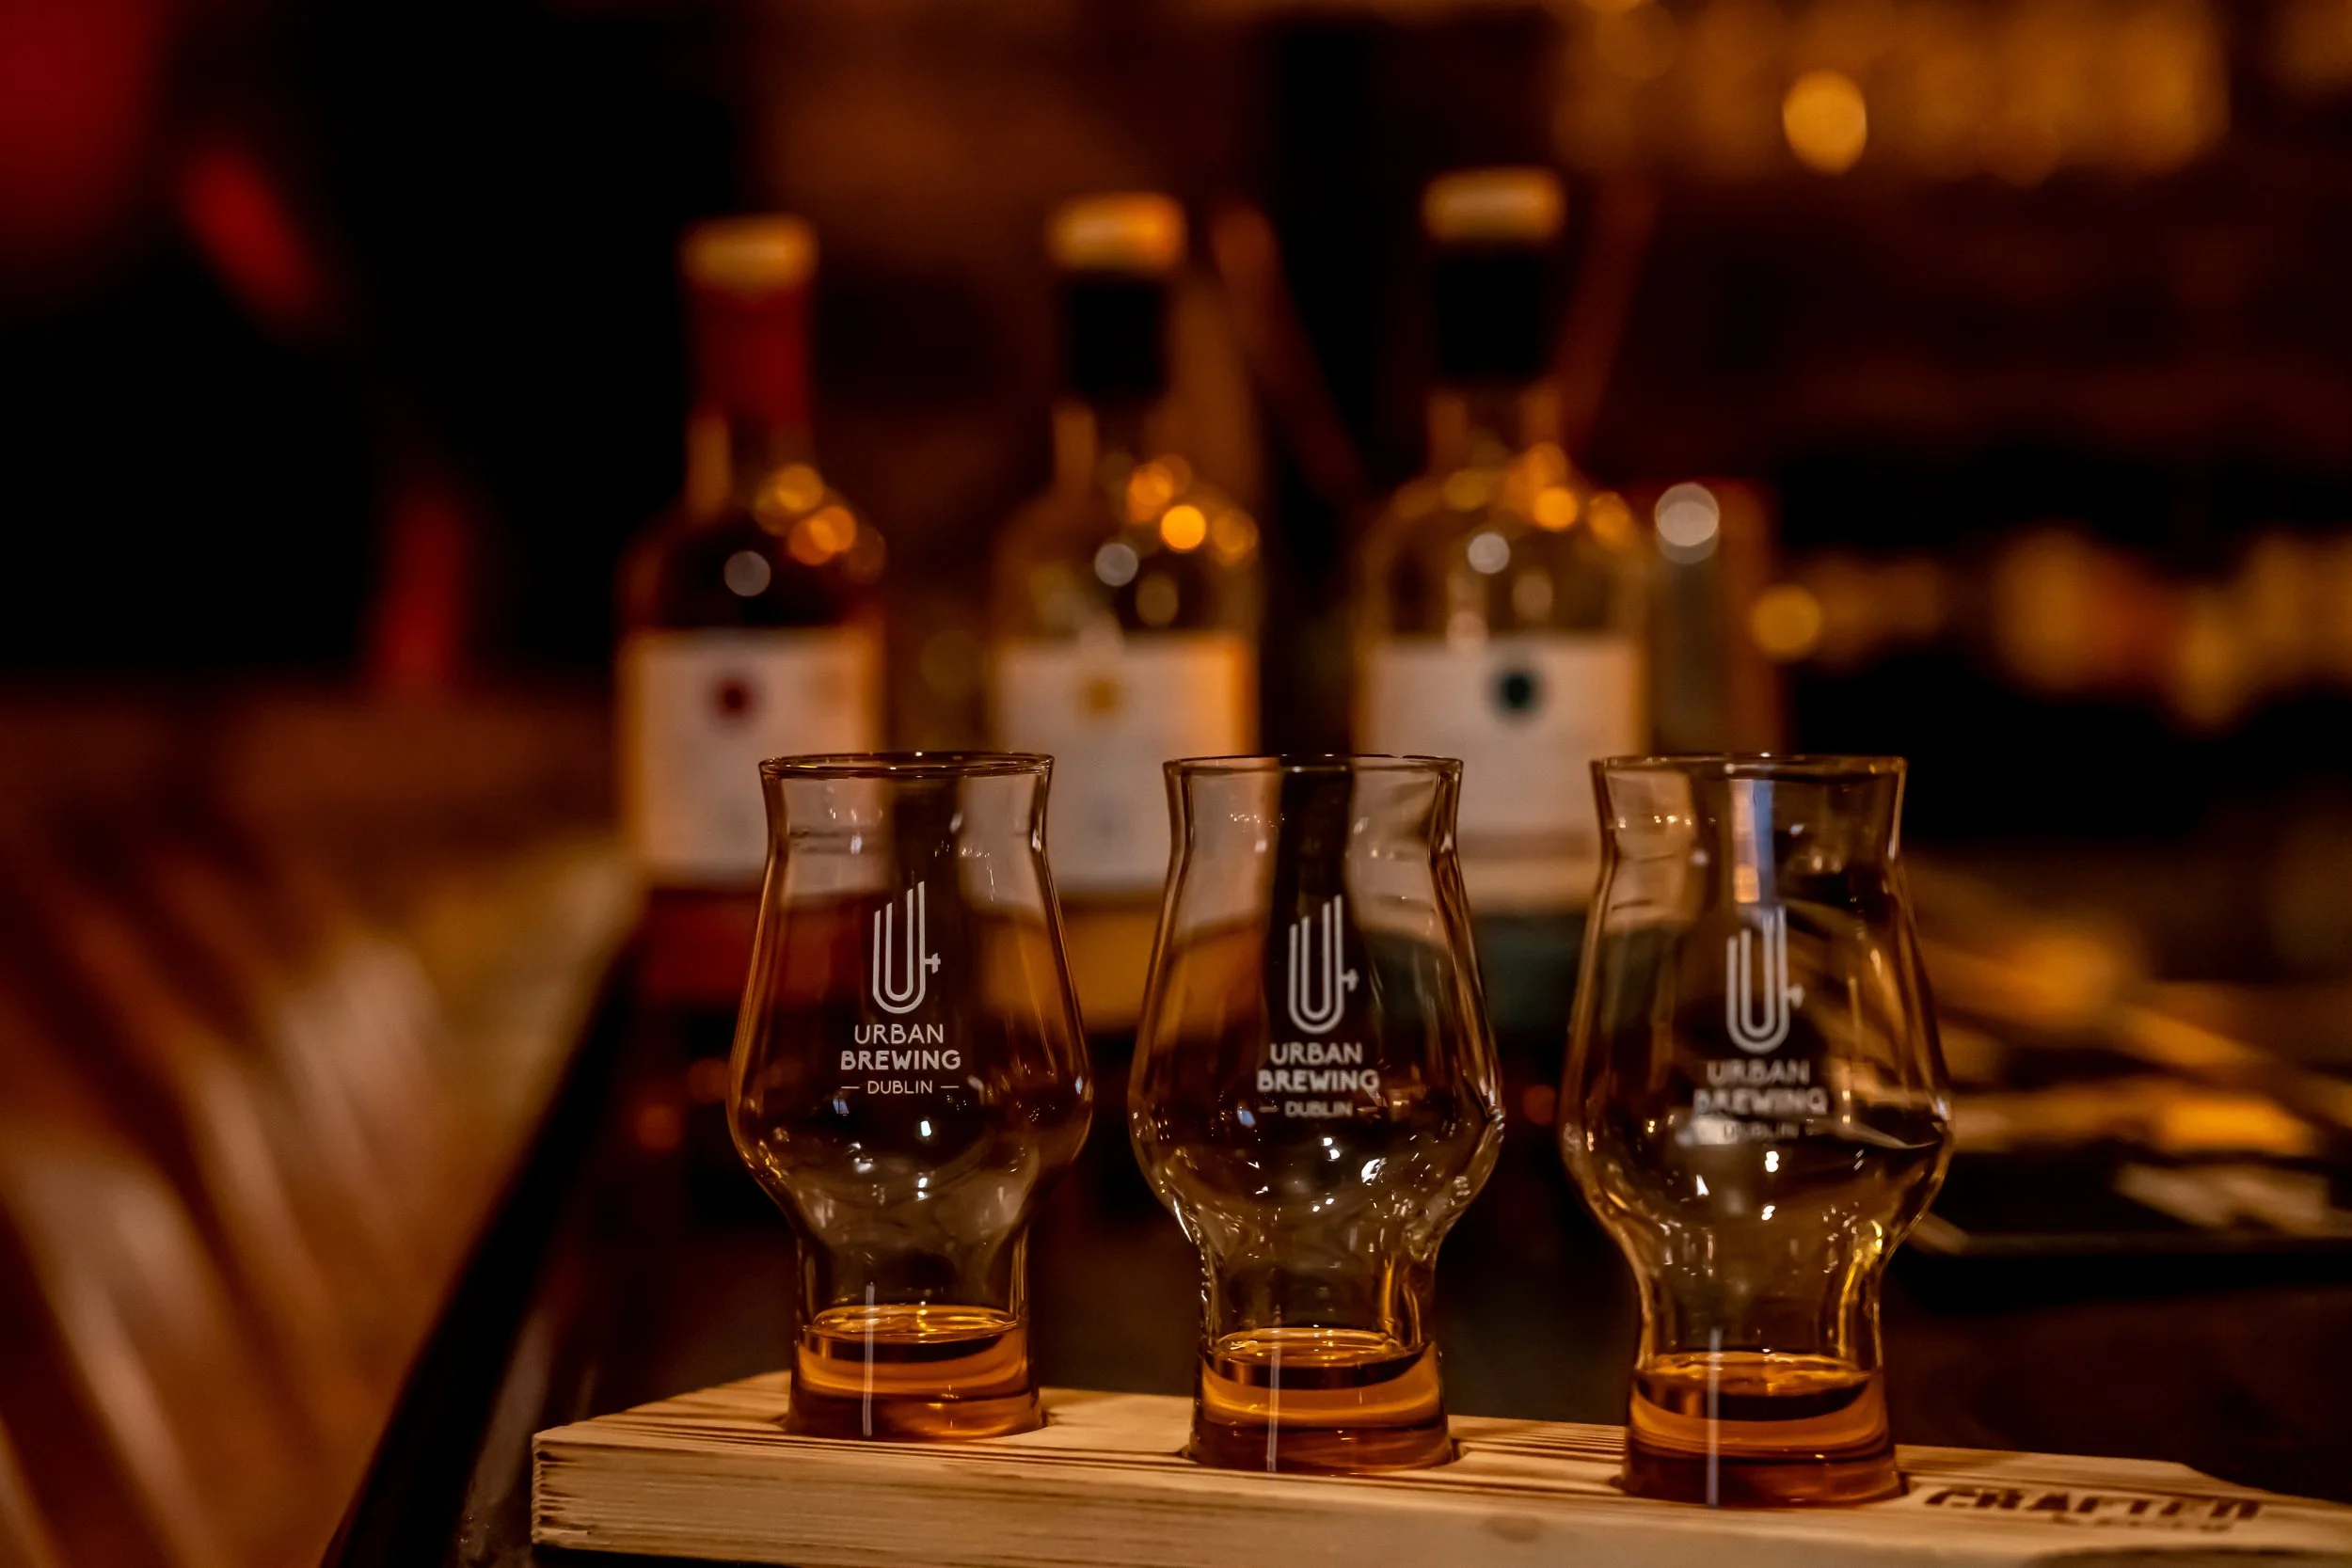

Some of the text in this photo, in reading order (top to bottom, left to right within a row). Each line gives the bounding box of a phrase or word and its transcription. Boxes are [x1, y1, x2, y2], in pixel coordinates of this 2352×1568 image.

[853, 1023, 944, 1044] URBAN
[840, 1049, 961, 1070] BREWING
[1270, 1042, 1362, 1065] URBAN
[1256, 1070, 1379, 1092] BREWING
[1707, 1059, 1810, 1084] URBAN
[867, 1080, 933, 1094] DUBLIN
[1284, 1101, 1353, 1117] DUBLIN
